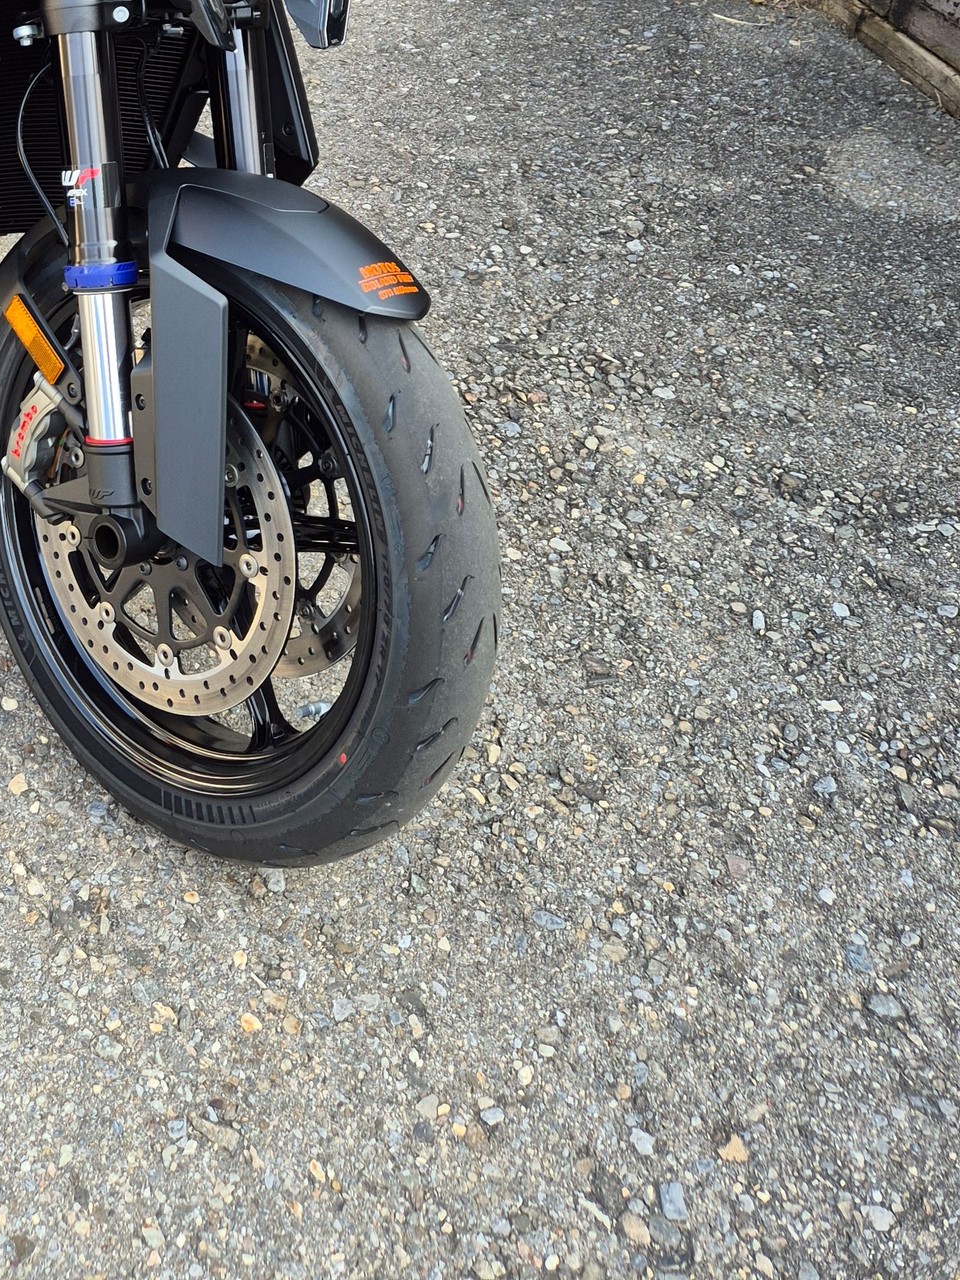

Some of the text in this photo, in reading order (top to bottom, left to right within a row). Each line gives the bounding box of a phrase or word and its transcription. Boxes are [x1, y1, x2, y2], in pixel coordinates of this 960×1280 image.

[61, 168, 100, 187] WP
[66, 188, 88, 198] APEX
[359, 262, 401, 279] MOTOS
[360, 275, 398, 293] ROLAND
[11, 404, 38, 458] brembo
[336, 403, 385, 531] MICHELIN
